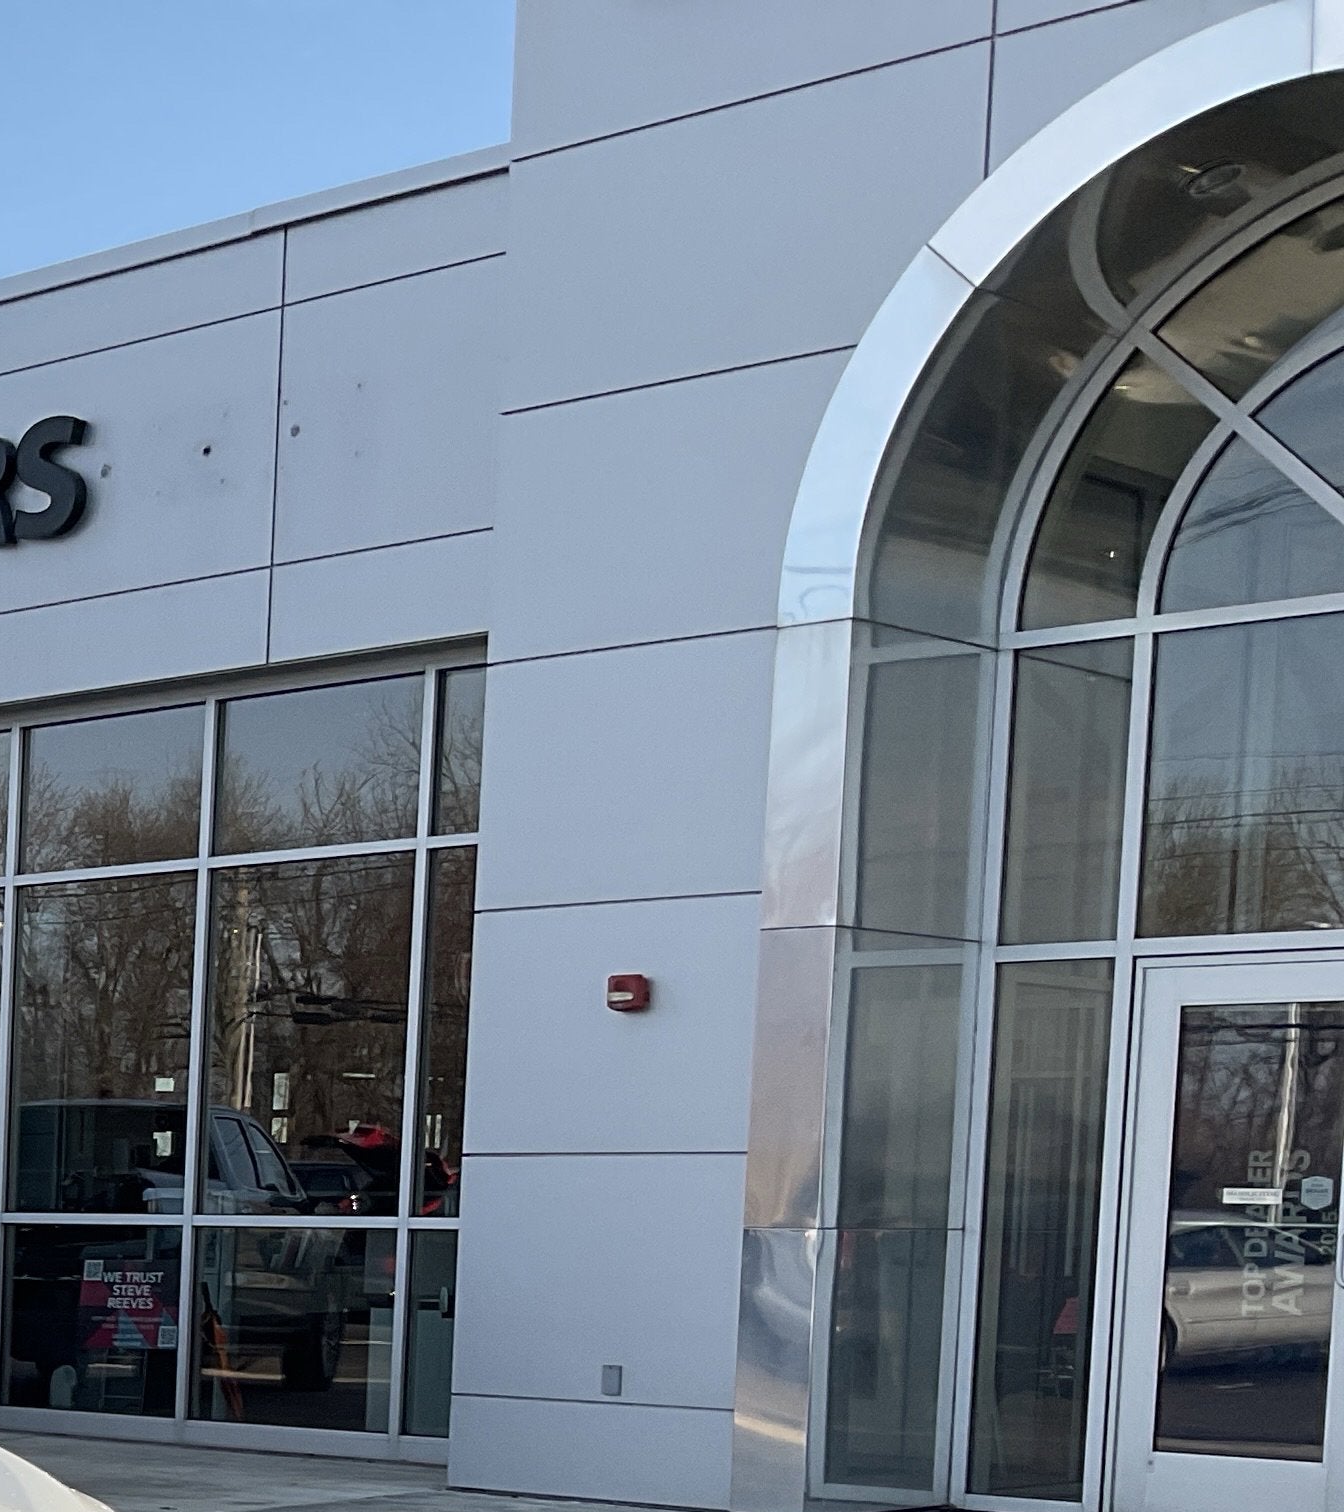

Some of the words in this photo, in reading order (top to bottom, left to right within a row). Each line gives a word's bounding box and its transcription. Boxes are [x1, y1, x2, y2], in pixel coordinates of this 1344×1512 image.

[1244, 1150, 1274, 1258] DEAER
[102, 1272, 123, 1283] WE
[126, 1272, 164, 1283] TRUST
[112, 1285, 151, 1296] STEVE
[1241, 1263, 1267, 1317] TOP
[107, 1297, 154, 1309] REEVES
